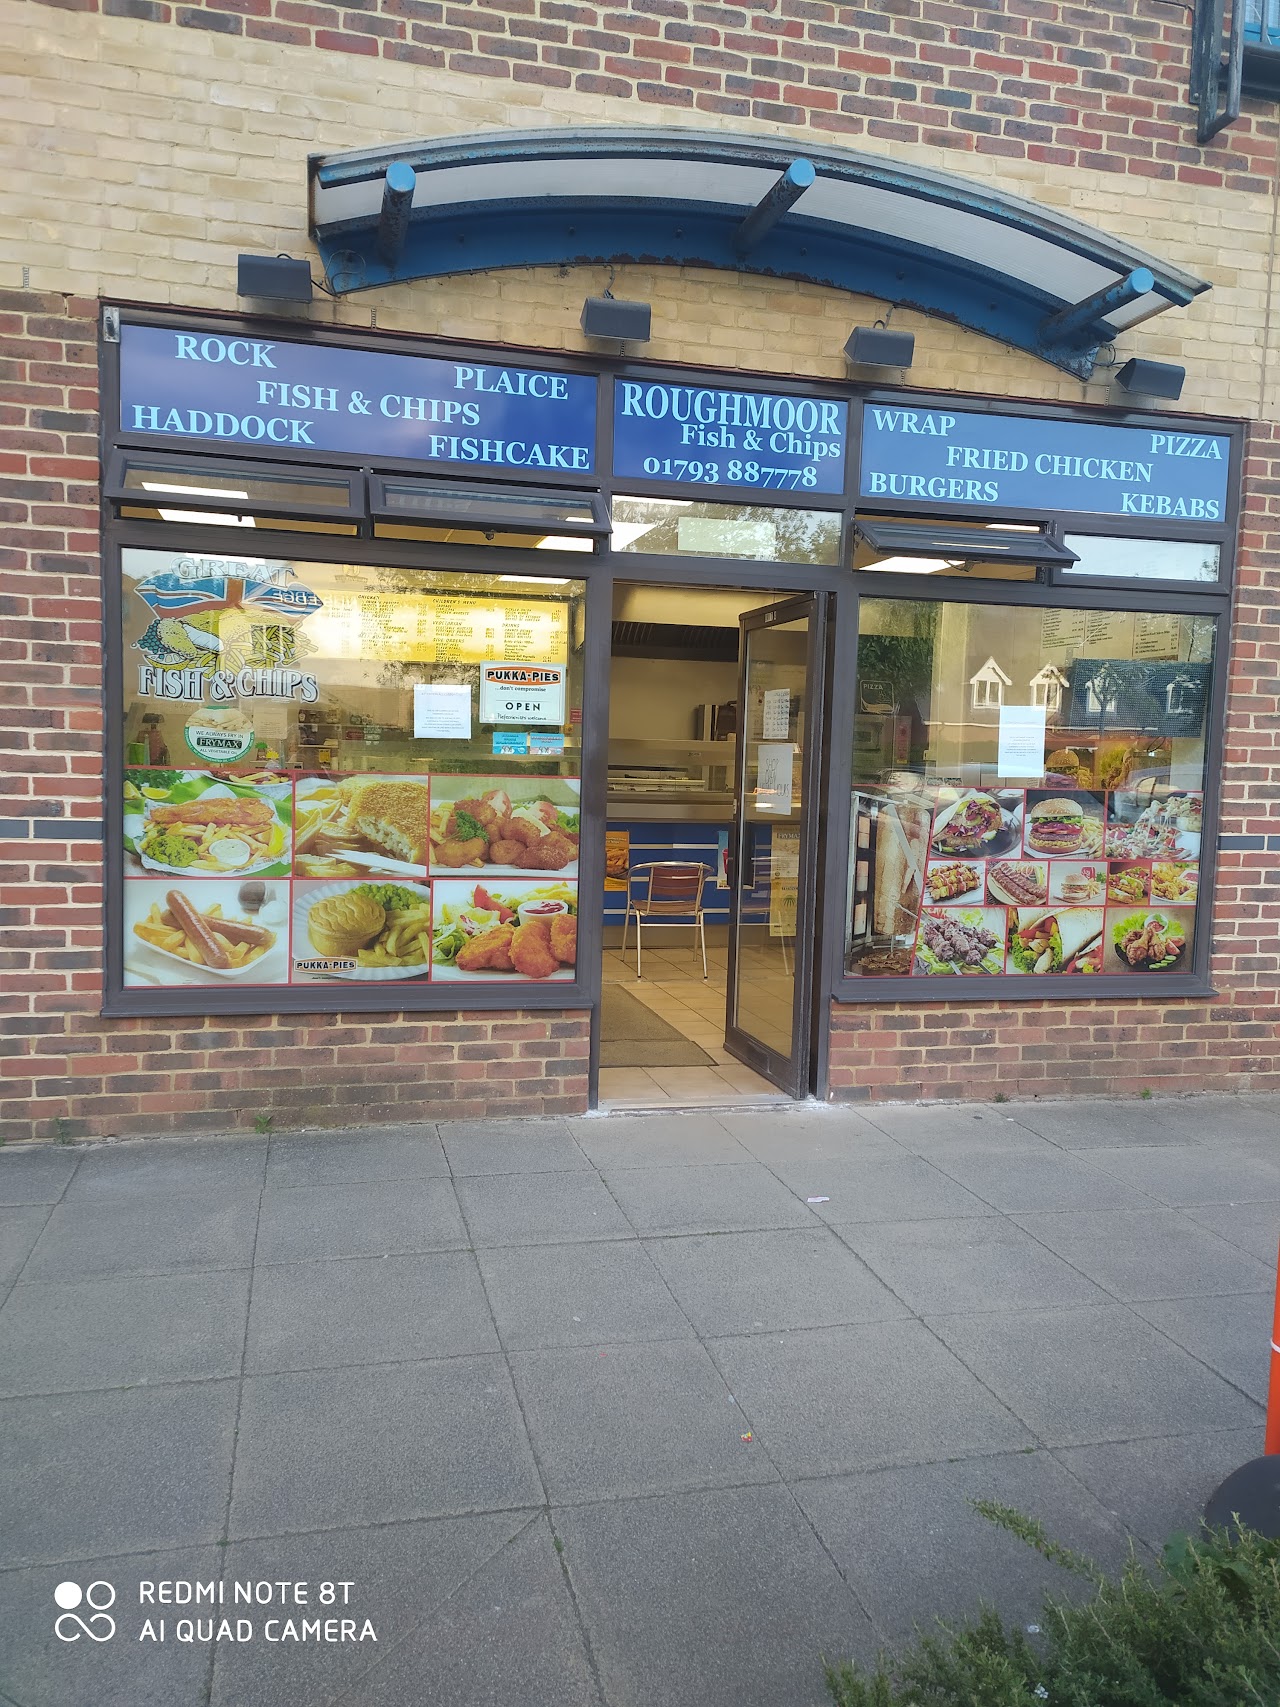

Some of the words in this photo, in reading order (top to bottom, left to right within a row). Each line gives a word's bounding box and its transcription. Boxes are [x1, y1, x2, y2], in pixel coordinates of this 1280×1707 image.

[175, 335, 278, 369] ROCK
[453, 365, 570, 400] PLAICE
[256, 380, 340, 412] FISH
[348, 391, 373, 416] &
[379, 394, 481, 426] CHIPS
[621, 382, 842, 436] ROUGHMOOR
[131, 404, 316, 445] HADDOCK
[872, 409, 957, 438] WRAP
[428, 434, 590, 470] FISHCAKE
[680, 423, 737, 449] Fish
[742, 429, 764, 451] &
[769, 431, 842, 459] Chips
[1149, 433, 1223, 460] PIZZA
[643, 457, 720, 484] 01793
[726, 459, 818, 490] 887778
[946, 446, 1029, 472] FRIED
[1034, 453, 1154, 483] CHICKEN
[868, 471, 999, 502] BURGERS
[1120, 492, 1220, 519] KEBABS
[171, 557, 298, 587] GREAT
[138, 664, 205, 702] FISH
[209, 669, 238, 701] &
[236, 666, 320, 704] CHIPS
[505, 702, 540, 711] OPEN
[200, 738, 239, 749] FRYMAX
